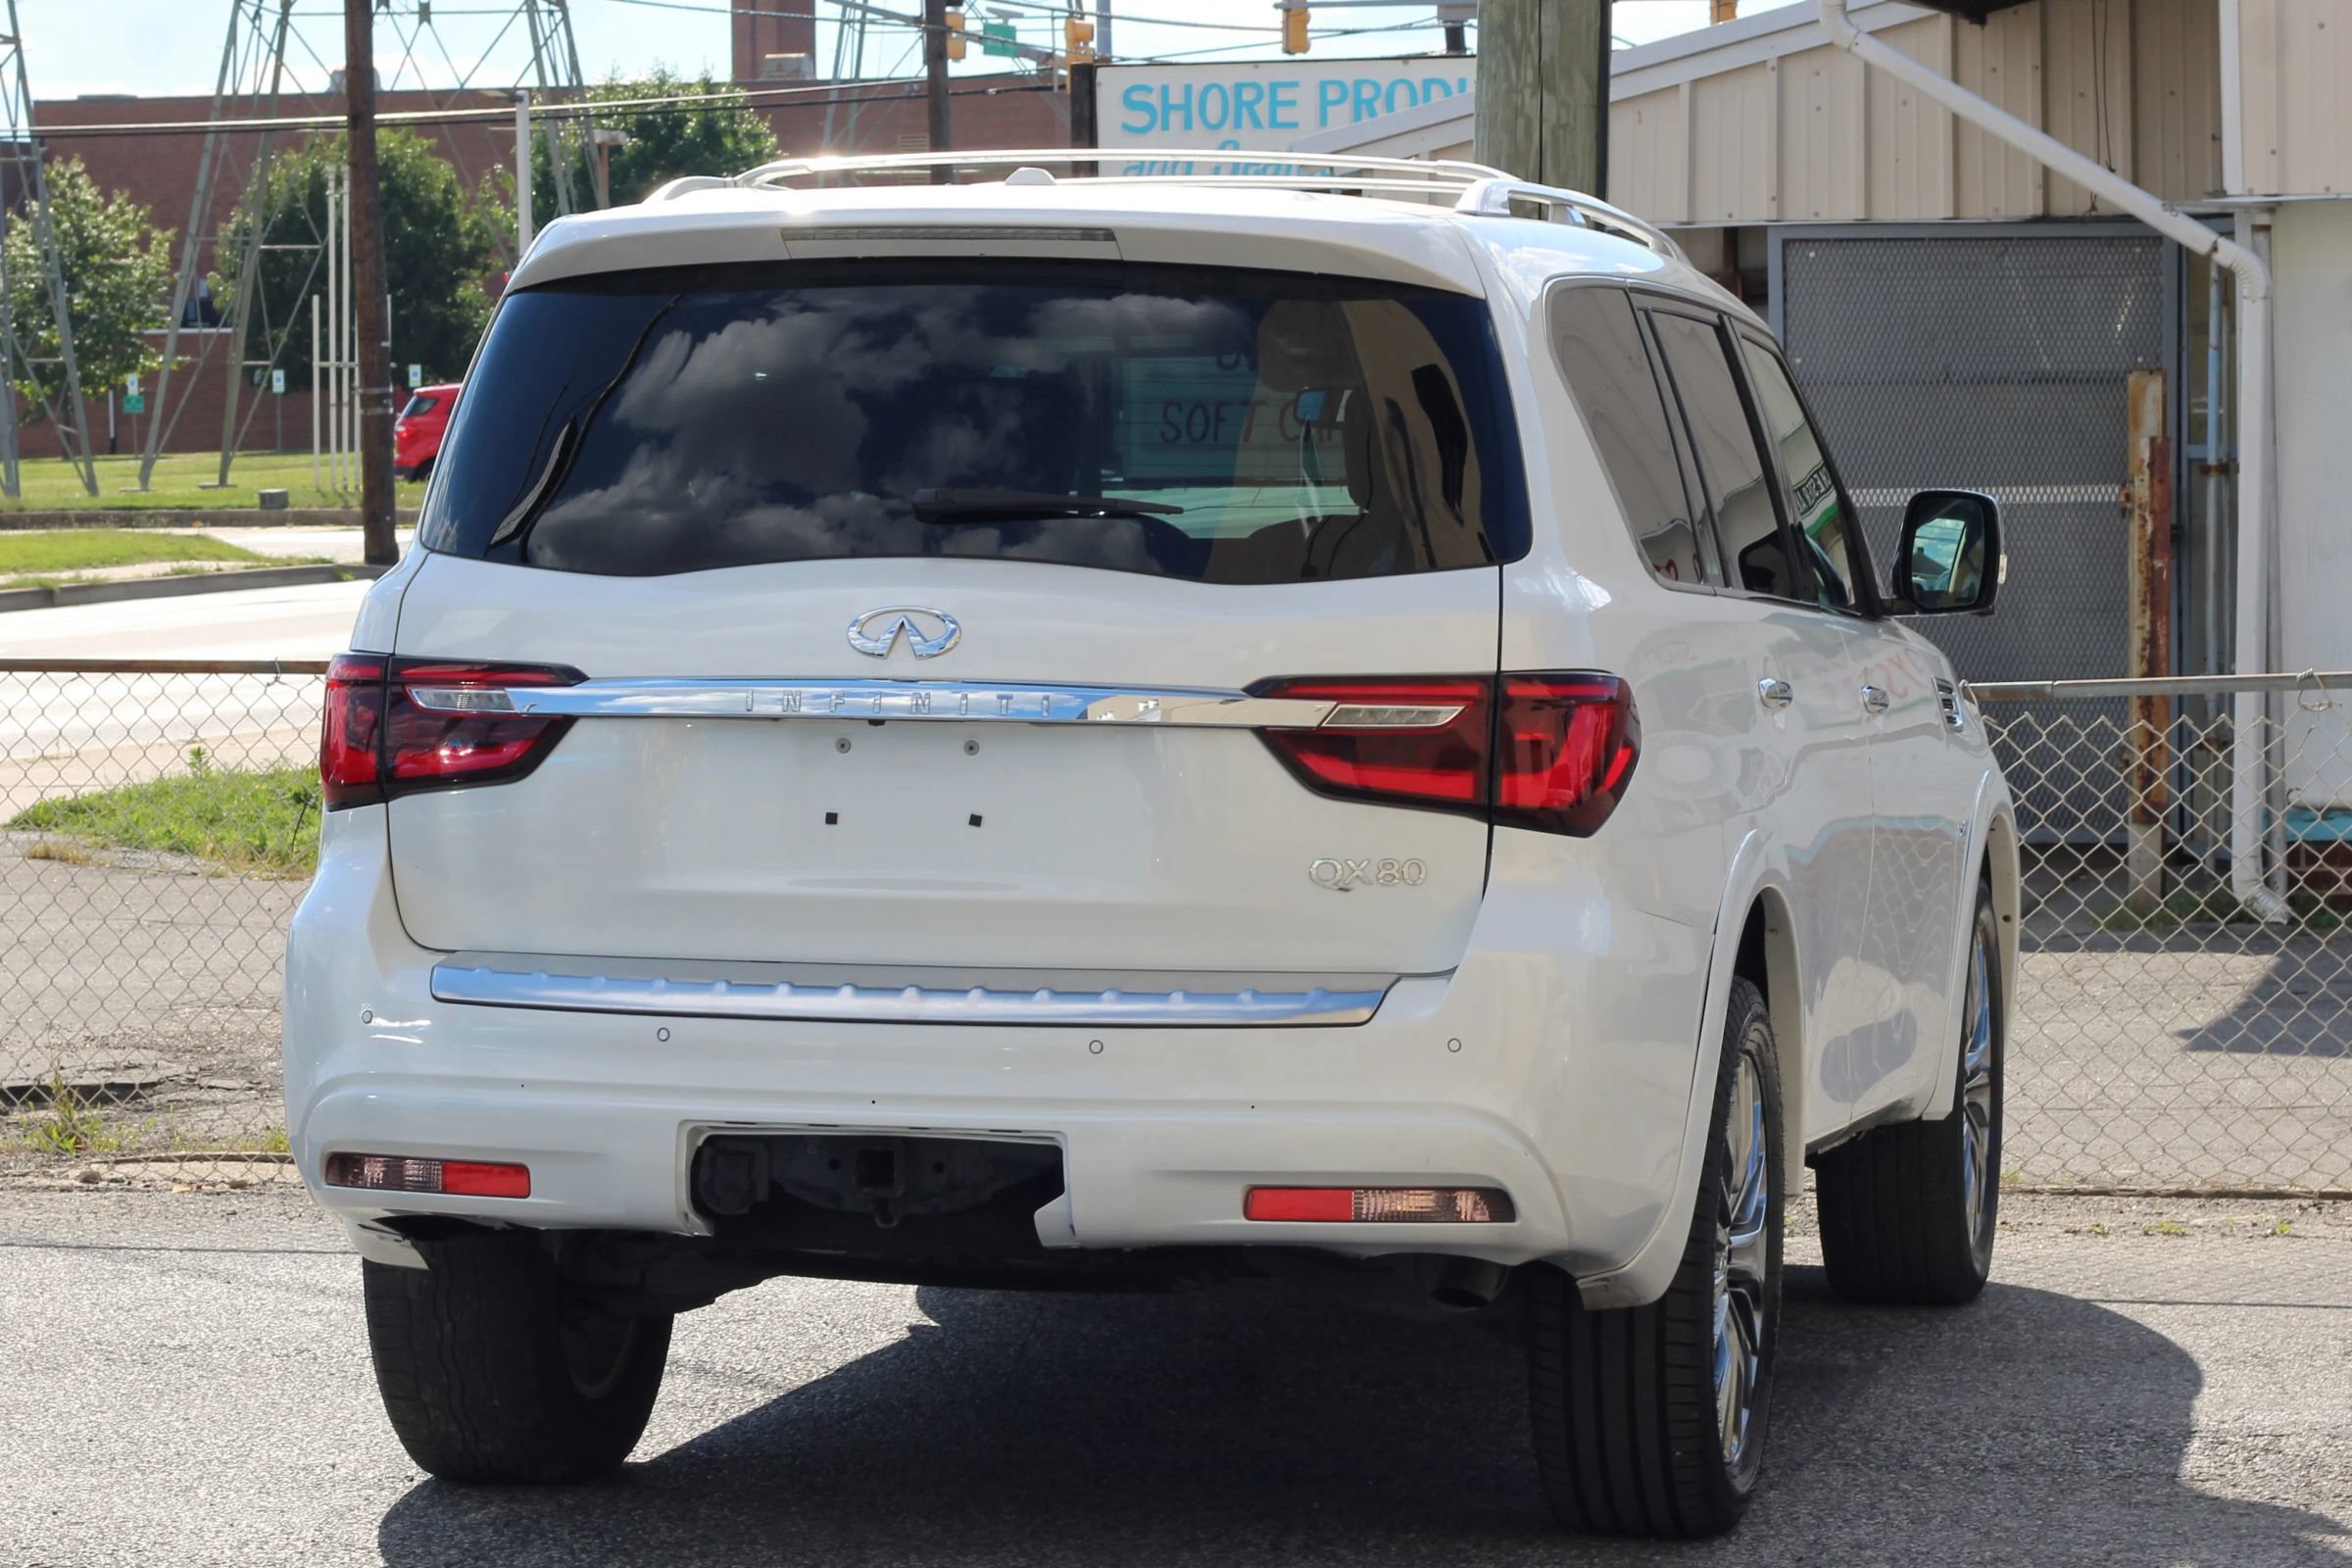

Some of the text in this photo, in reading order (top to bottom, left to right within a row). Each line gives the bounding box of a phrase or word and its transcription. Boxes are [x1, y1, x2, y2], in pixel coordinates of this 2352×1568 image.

[1121, 80, 1300, 134] SHORE
[1159, 400, 1268, 443] SOFT
[745, 689, 1051, 718] INFINITI
[1309, 858, 1427, 892] QX80
